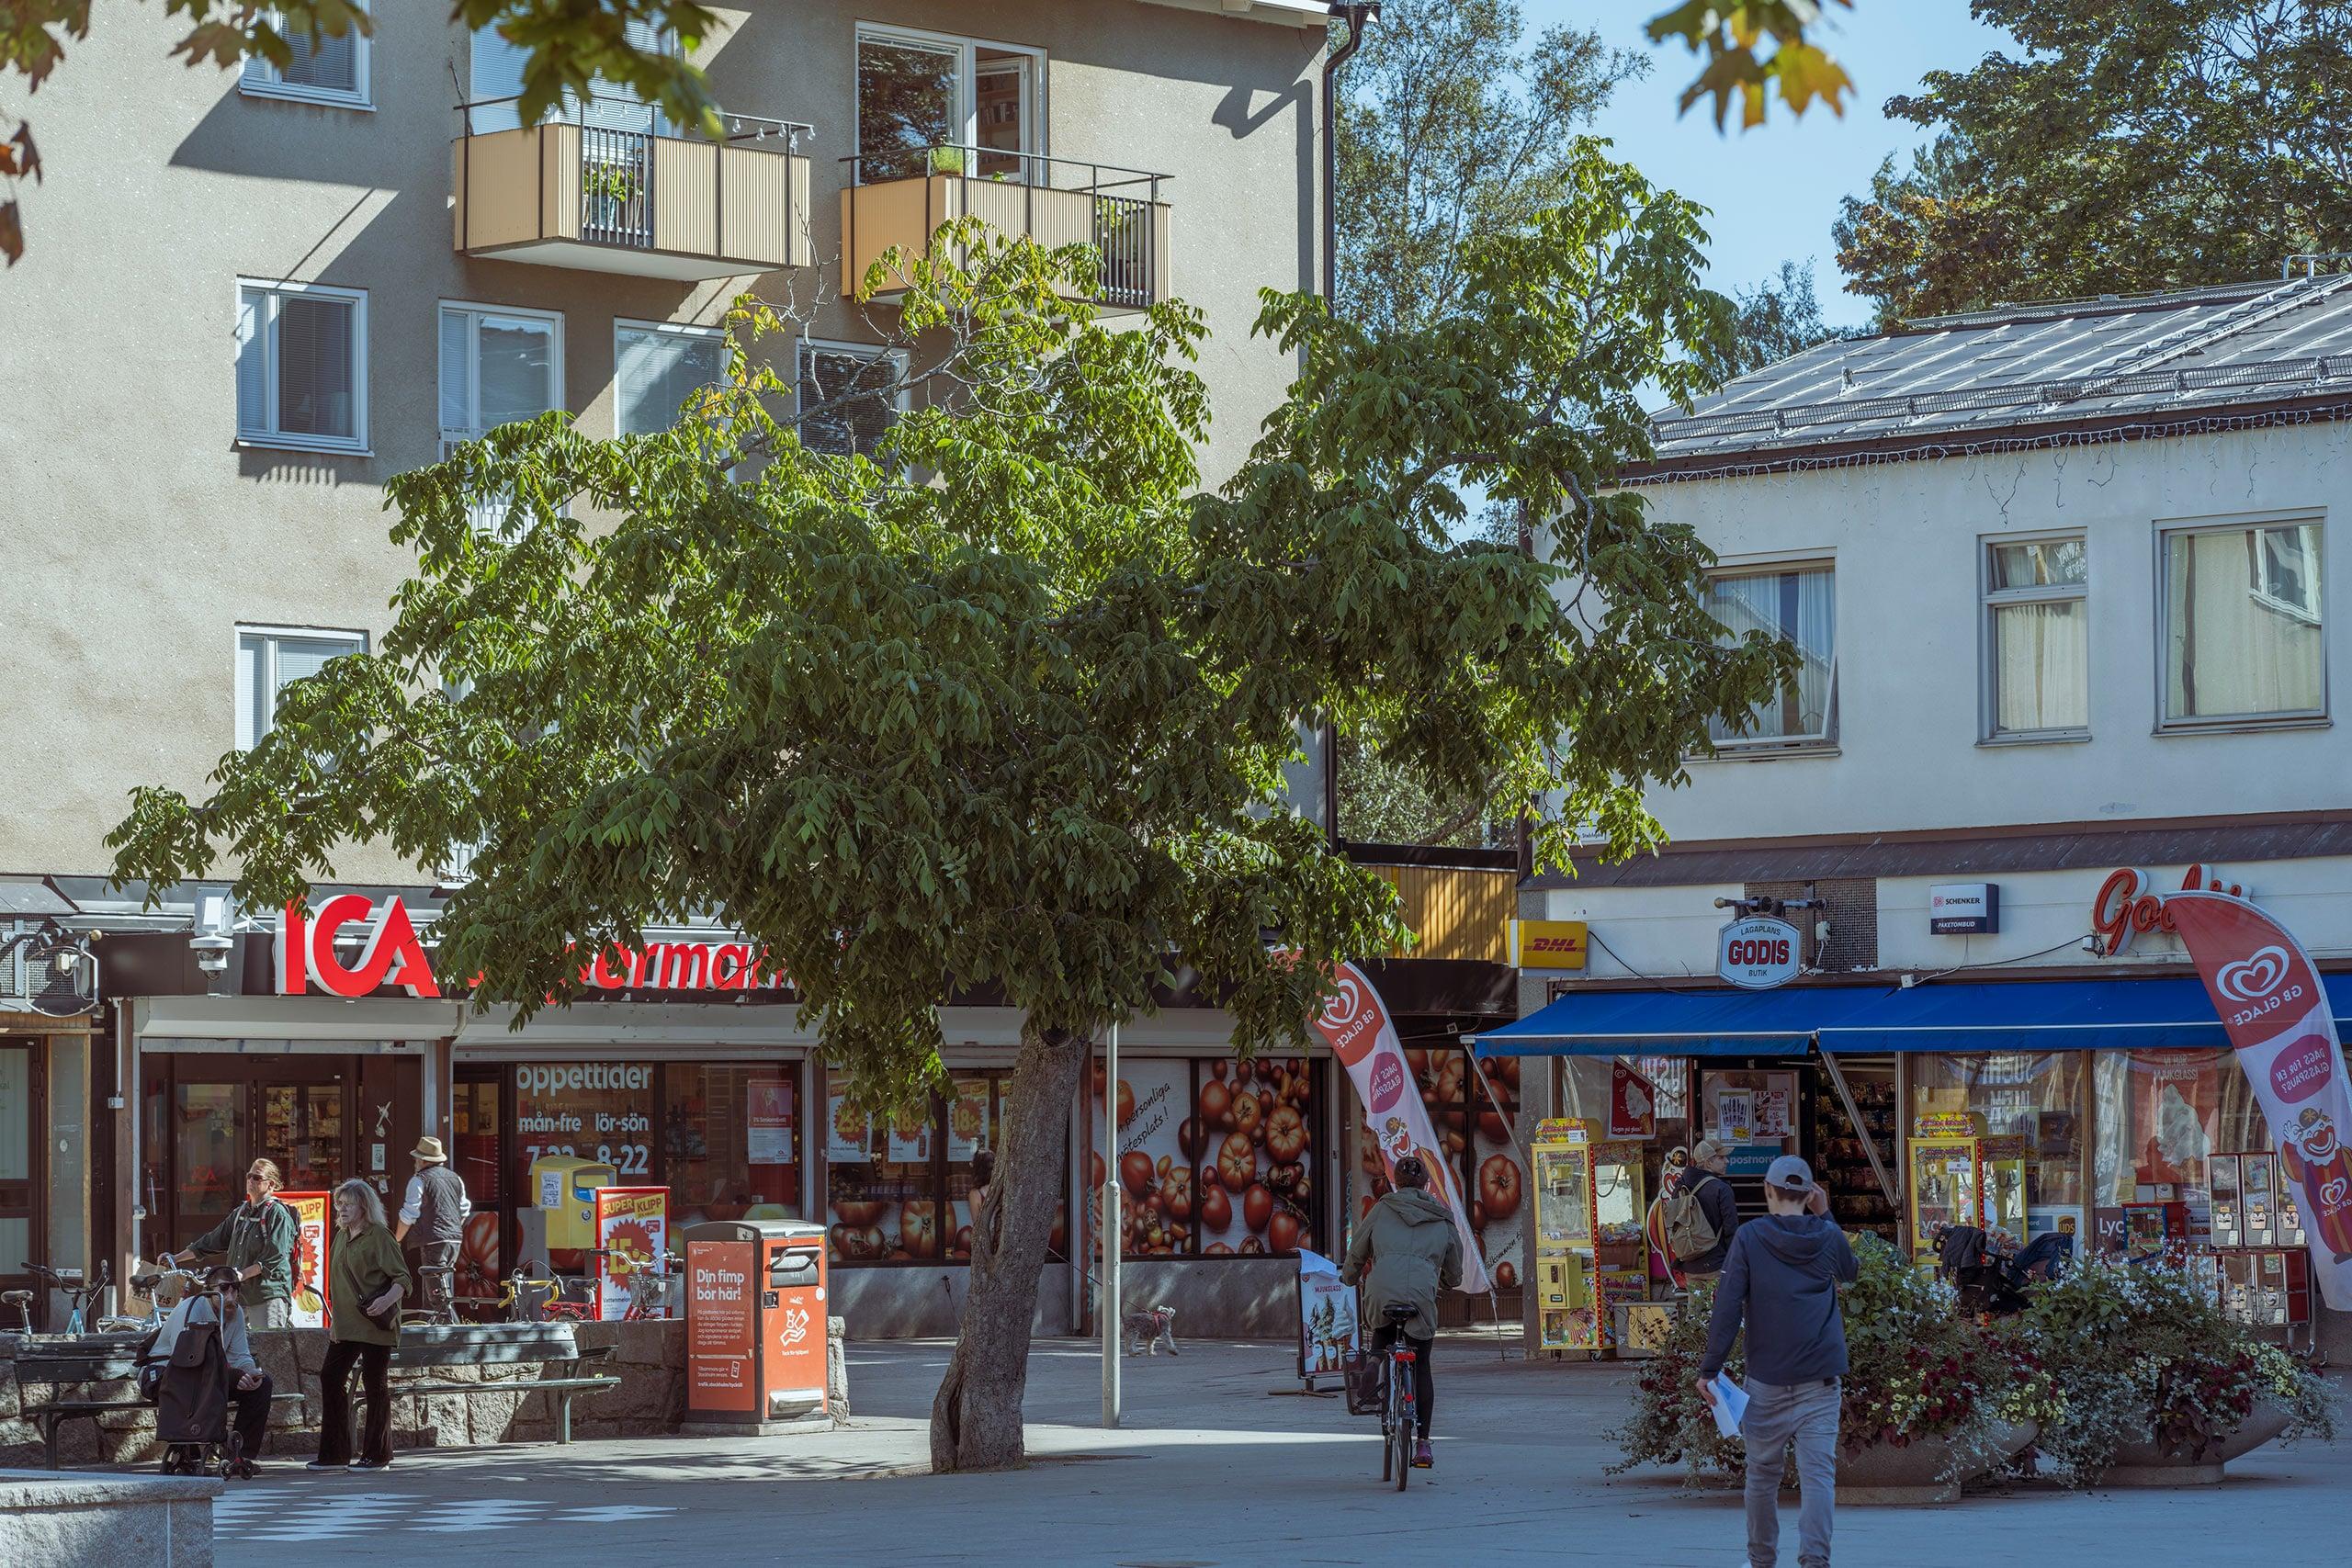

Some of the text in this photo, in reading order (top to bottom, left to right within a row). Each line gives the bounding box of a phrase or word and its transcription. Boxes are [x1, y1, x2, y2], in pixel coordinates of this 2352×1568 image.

[1945, 897, 1981, 906] SCHENKER
[1739, 924, 1782, 937] LAGAPLANS
[1938, 920, 1976, 929] PAKETOMBUD
[276, 893, 440, 997] ICA
[1532, 938, 1579, 952] DHL
[1727, 939, 1791, 965] GODIS
[1747, 968, 1769, 977] BUTIK
[1125, 1082, 1171, 1133] personliga
[518, 1111, 649, 1132] mån-fre lör-sön
[597, 1145, 649, 1175] 8-22
[1730, 1155, 1776, 1166] postnord
[299, 1201, 322, 1215] LIPP
[603, 1198, 662, 1214] SUPER KLIPP
[696, 1269, 745, 1287] Din fimp
[696, 1286, 741, 1301] bor här!
[1314, 1284, 1342, 1293] MJUKGLASS
